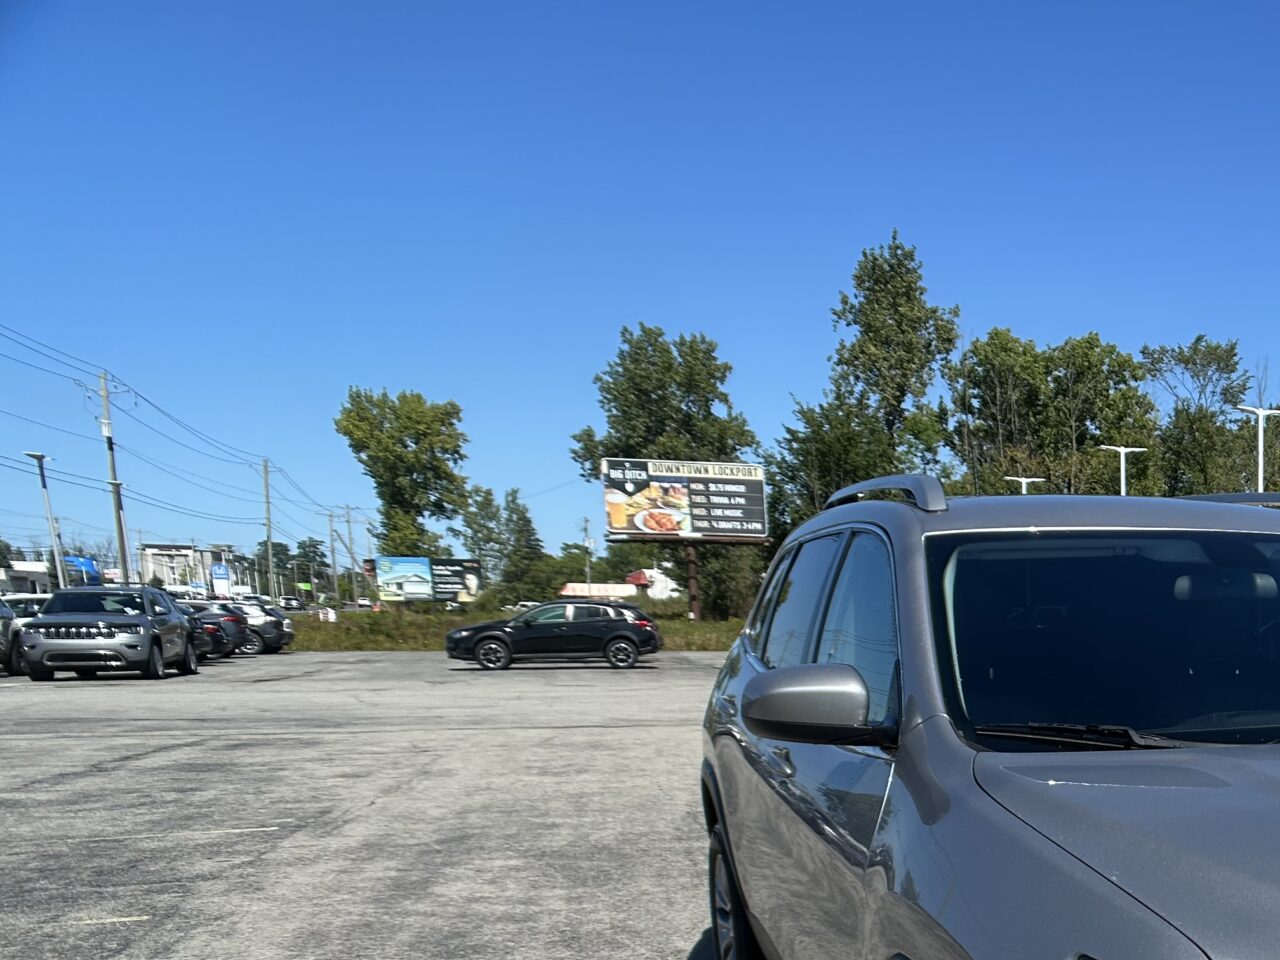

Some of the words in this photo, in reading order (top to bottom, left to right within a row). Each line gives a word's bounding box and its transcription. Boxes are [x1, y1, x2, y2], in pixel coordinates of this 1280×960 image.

[609, 469, 624, 479] BIG
[652, 462, 709, 475] DOWNTOWN
[713, 466, 759, 478] LOCKPORT
